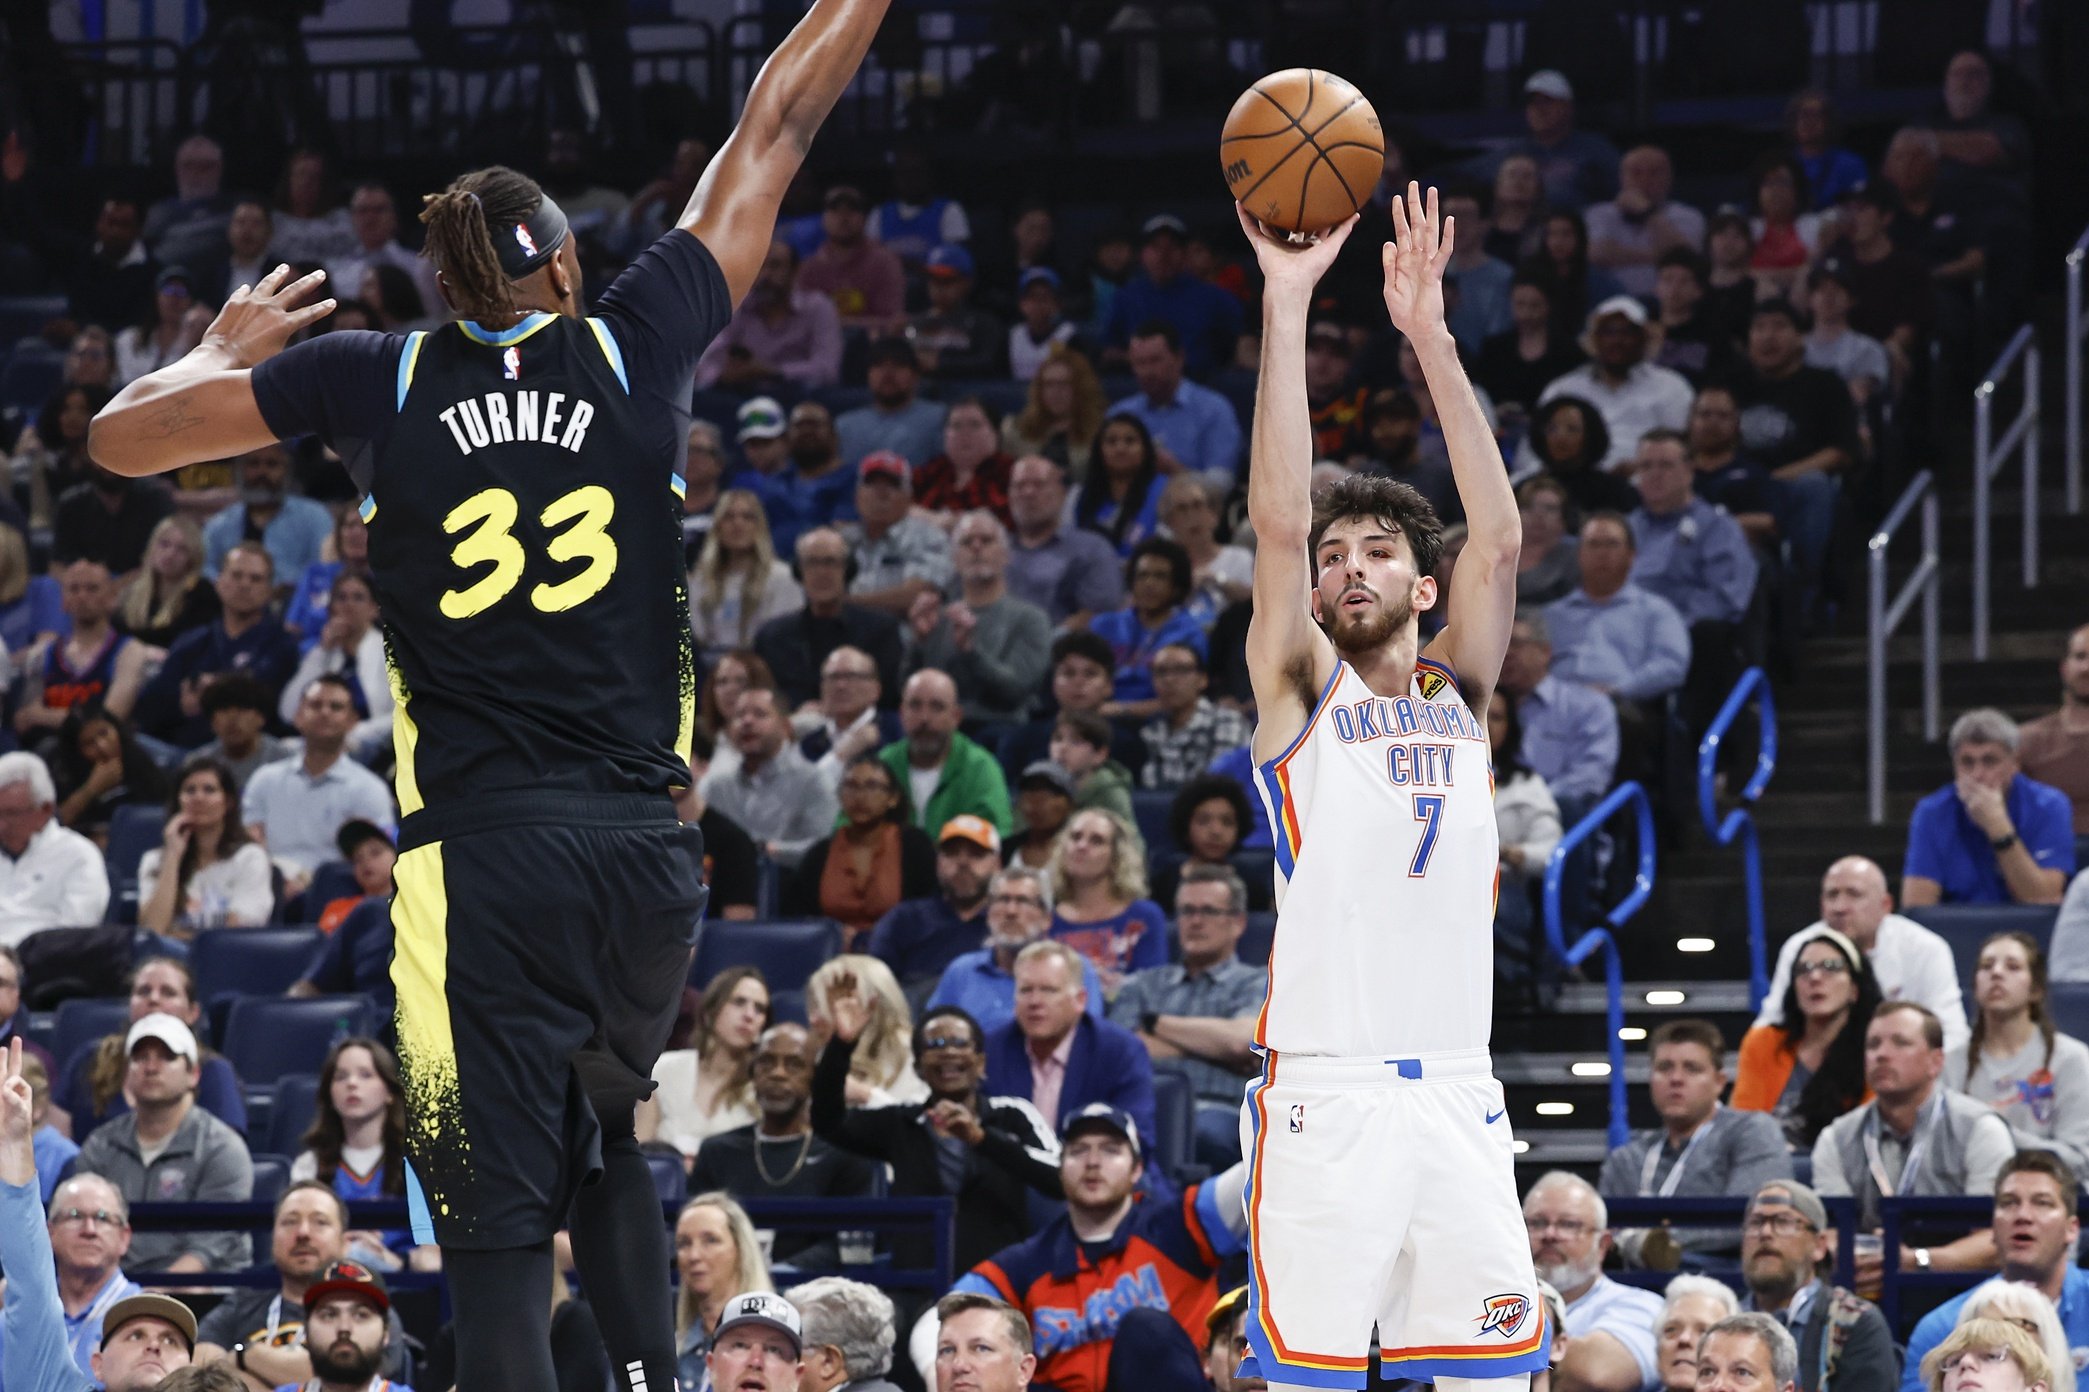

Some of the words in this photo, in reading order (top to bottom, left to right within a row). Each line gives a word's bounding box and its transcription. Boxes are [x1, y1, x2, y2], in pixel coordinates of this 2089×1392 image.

[439, 390, 595, 456] TURNER
[439, 485, 618, 619] 33
[1387, 743, 1455, 787] CITY
[1408, 793, 1445, 878] 7
[1482, 1301, 1522, 1331] OKC
